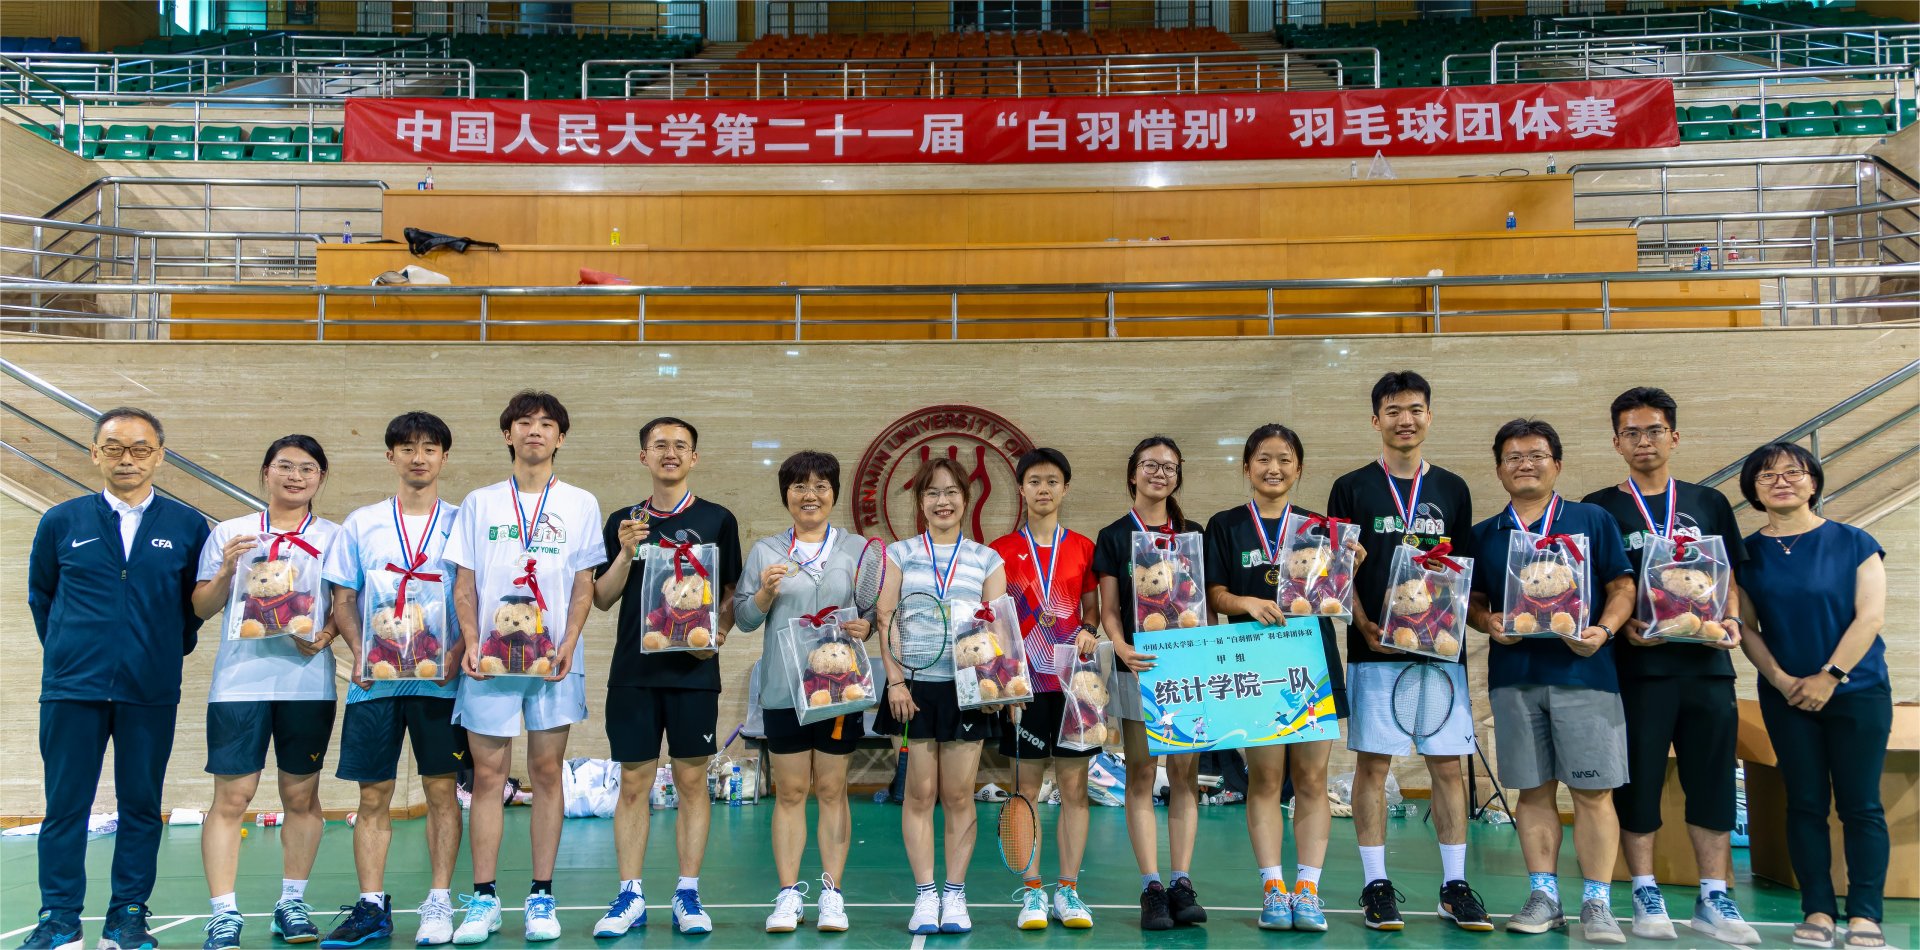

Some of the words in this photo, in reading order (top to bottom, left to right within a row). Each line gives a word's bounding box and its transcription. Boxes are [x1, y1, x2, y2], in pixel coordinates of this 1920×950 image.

[862, 449, 892, 526] RENMIN
[887, 413, 1003, 450] UNIVERSITY
[1005, 438, 1026, 458] OF
[151, 538, 173, 549] CFA
[1154, 666, 1317, 705] 统计学院一队
[1017, 725, 1046, 750] ICTOR
[1571, 769, 1600, 779] NASA
